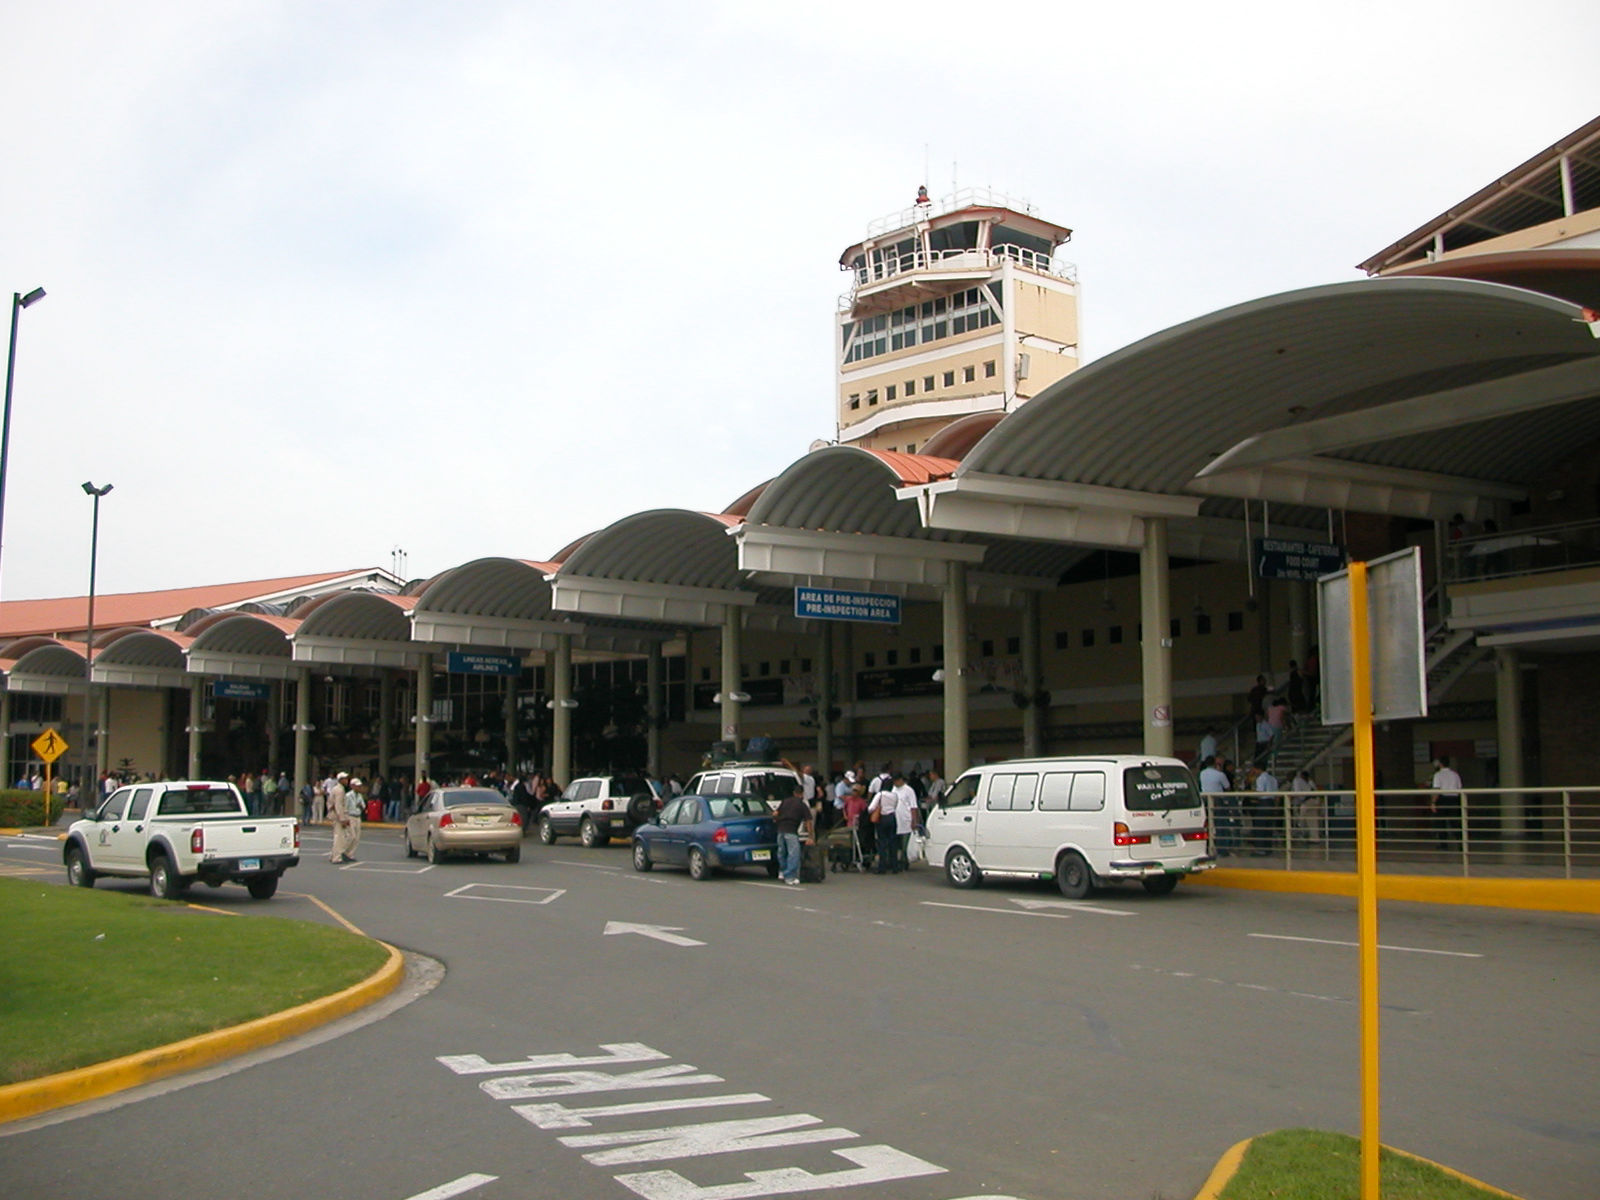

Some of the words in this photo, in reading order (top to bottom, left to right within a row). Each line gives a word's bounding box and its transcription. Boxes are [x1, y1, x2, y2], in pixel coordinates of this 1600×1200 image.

[800, 592, 822, 602] AREA
[823, 594, 834, 603] DE
[836, 595, 897, 608] PRE-INSPECCION
[806, 603, 868, 616] PRE-INSPECTION
[870, 609, 891, 618] AREA
